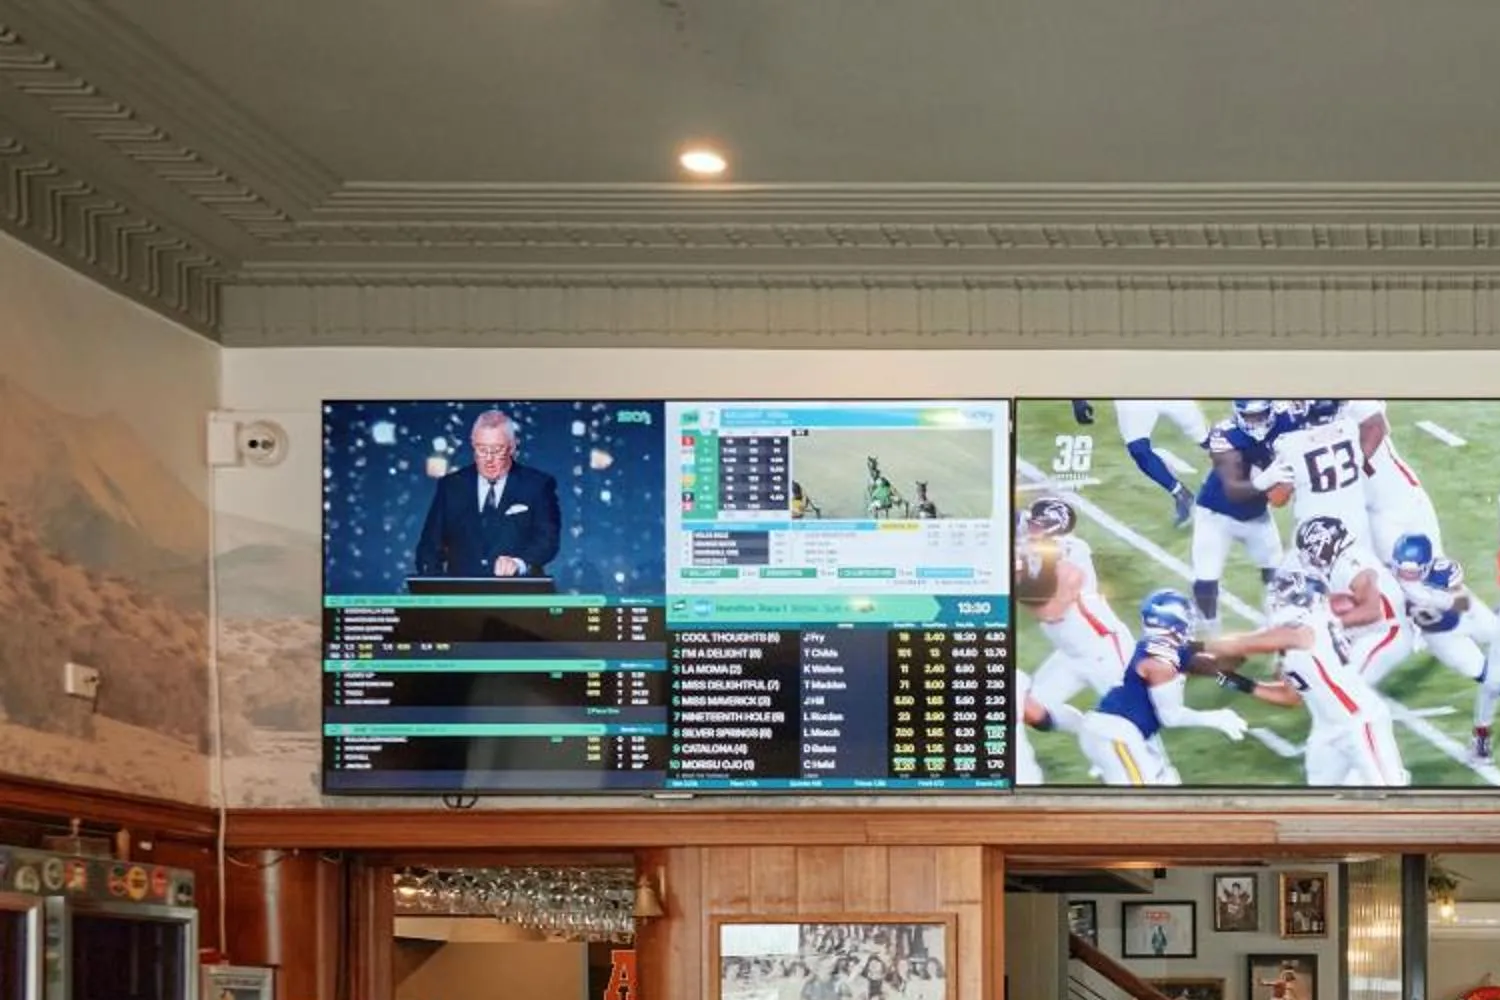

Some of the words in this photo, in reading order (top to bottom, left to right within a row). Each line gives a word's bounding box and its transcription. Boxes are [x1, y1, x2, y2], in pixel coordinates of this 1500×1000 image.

[1304, 440, 1359, 493] 63
[682, 632, 710, 642] COOL
[712, 632, 766, 642] THOUGHTS
[698, 648, 706, 658] A
[707, 648, 748, 658] DELIGHT
[682, 664, 694, 674] LA
[746, 712, 771, 722] HOLE
[682, 728, 714, 738] SILVER
